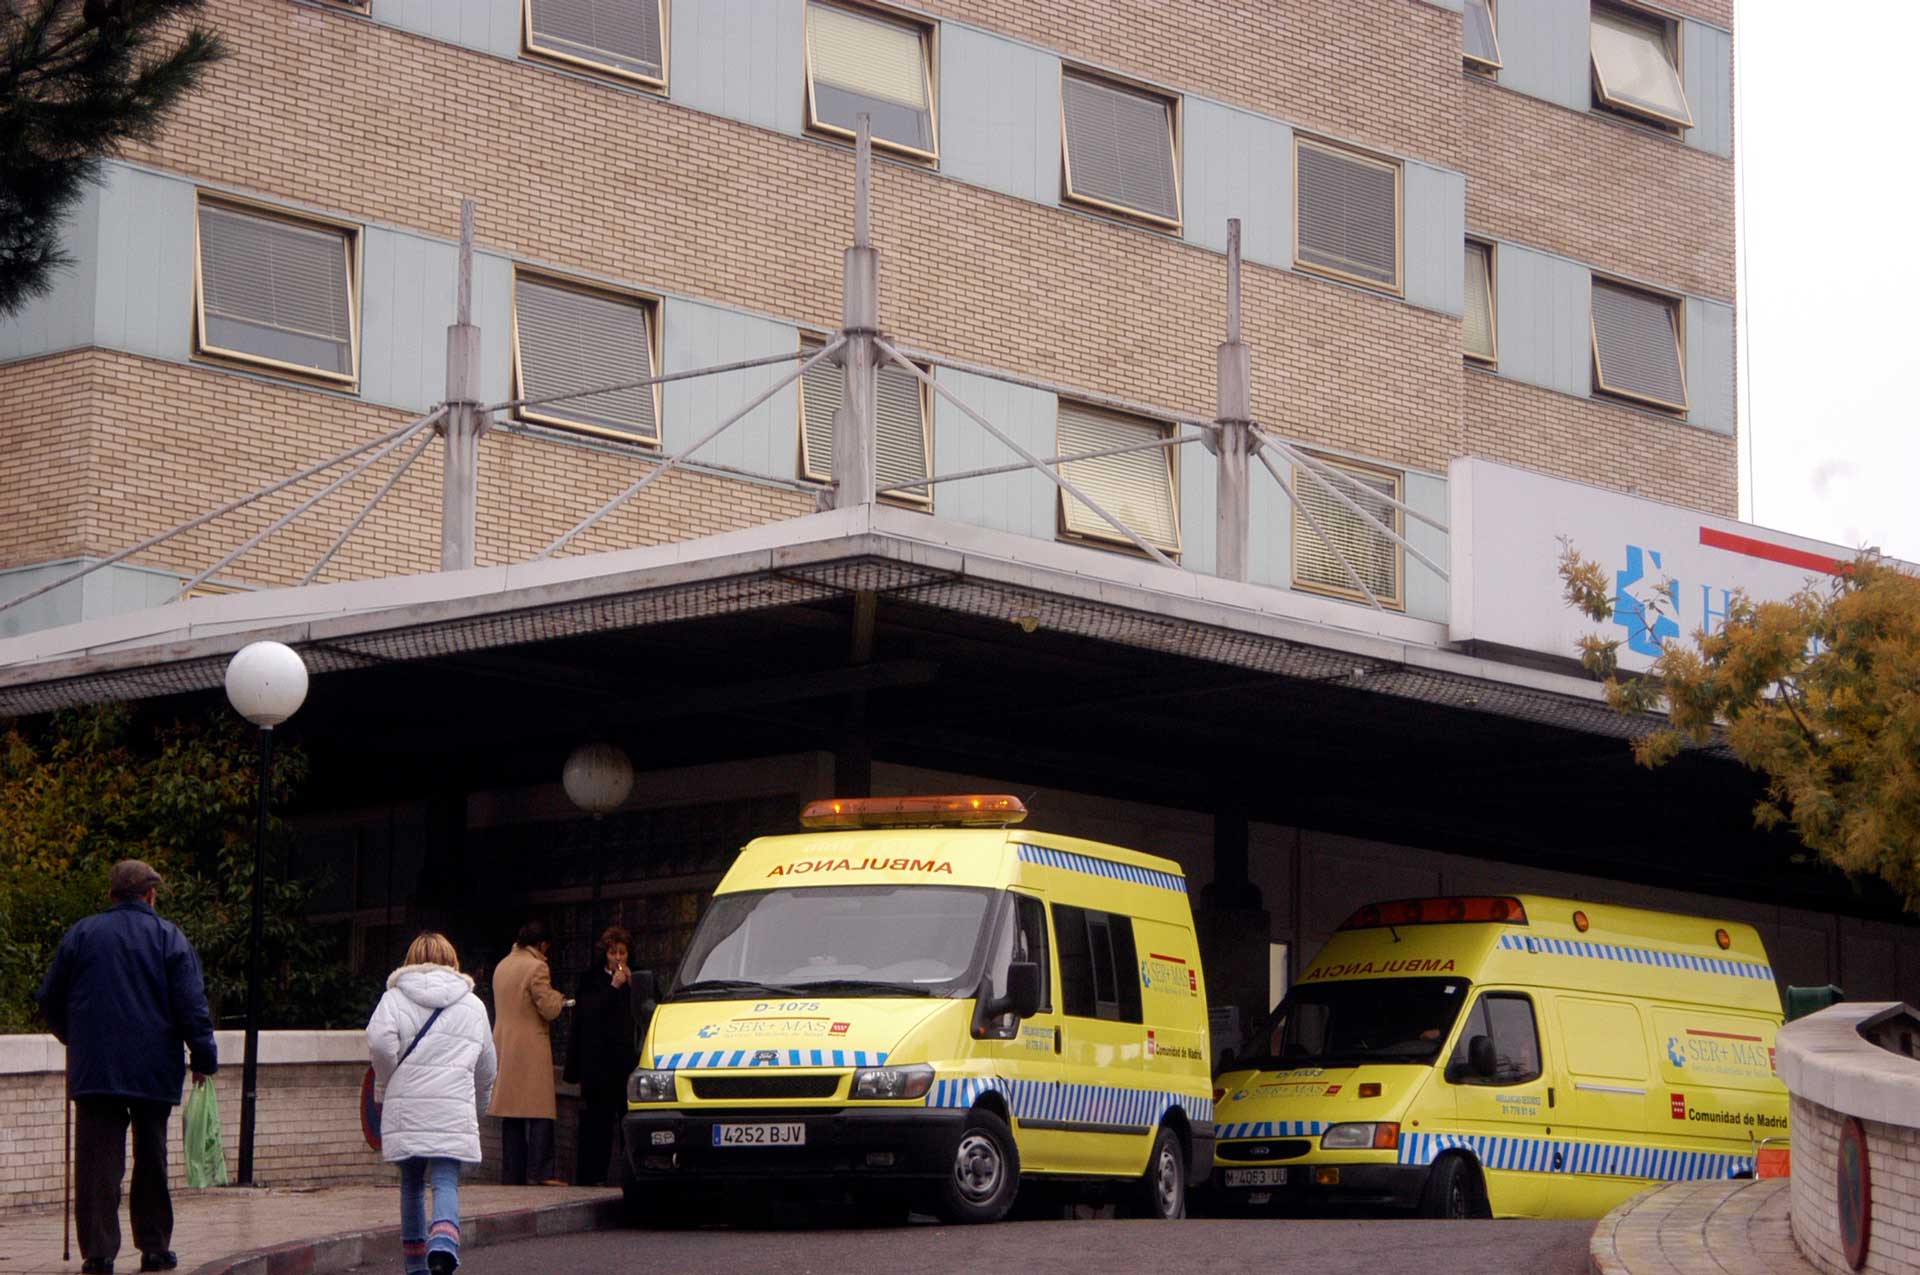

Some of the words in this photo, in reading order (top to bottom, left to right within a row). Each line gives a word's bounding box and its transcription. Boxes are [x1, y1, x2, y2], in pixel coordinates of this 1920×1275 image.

[754, 1002, 820, 1013] D-1075
[782, 1020, 828, 1033] MAS
[1731, 1043, 1768, 1067] MAS
[1688, 1108, 1741, 1125] Comunidad
[1743, 1113, 1755, 1126] de
[1757, 1113, 1788, 1129] Madrid
[724, 1127, 765, 1143] 4252
[770, 1126, 801, 1143] BJV
